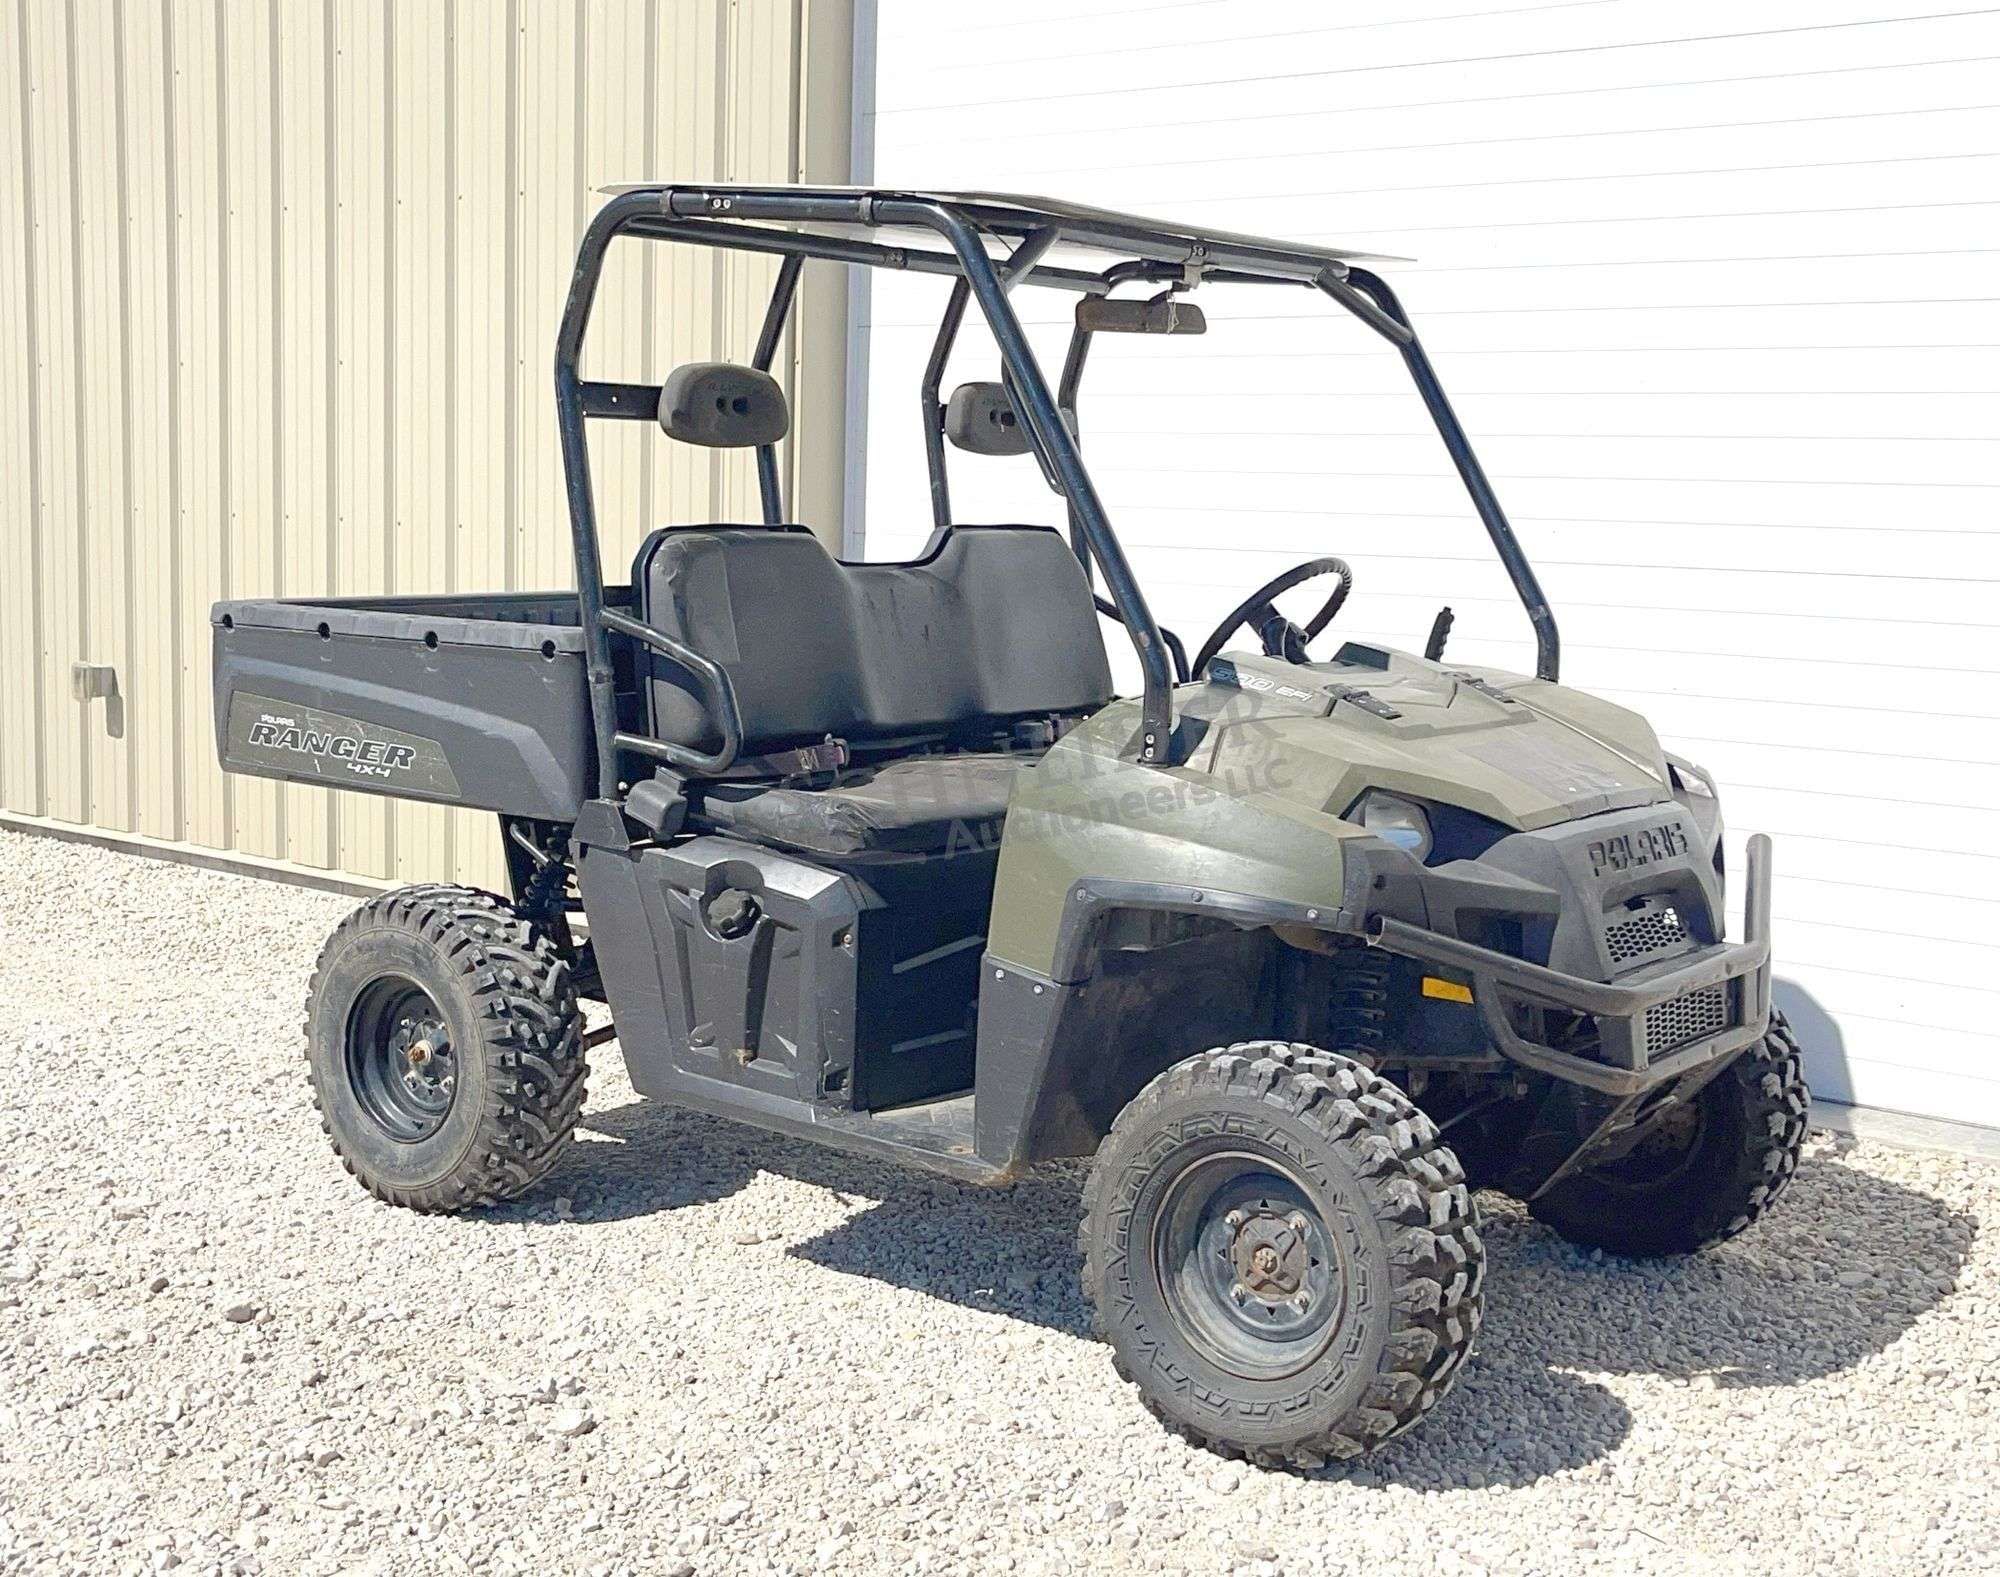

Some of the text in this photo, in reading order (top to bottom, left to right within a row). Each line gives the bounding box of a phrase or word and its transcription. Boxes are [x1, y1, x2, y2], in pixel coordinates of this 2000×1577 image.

[260, 713, 295, 727] POLARIS
[249, 722, 416, 770] RANGER
[1587, 822, 1689, 877] POLARIS
